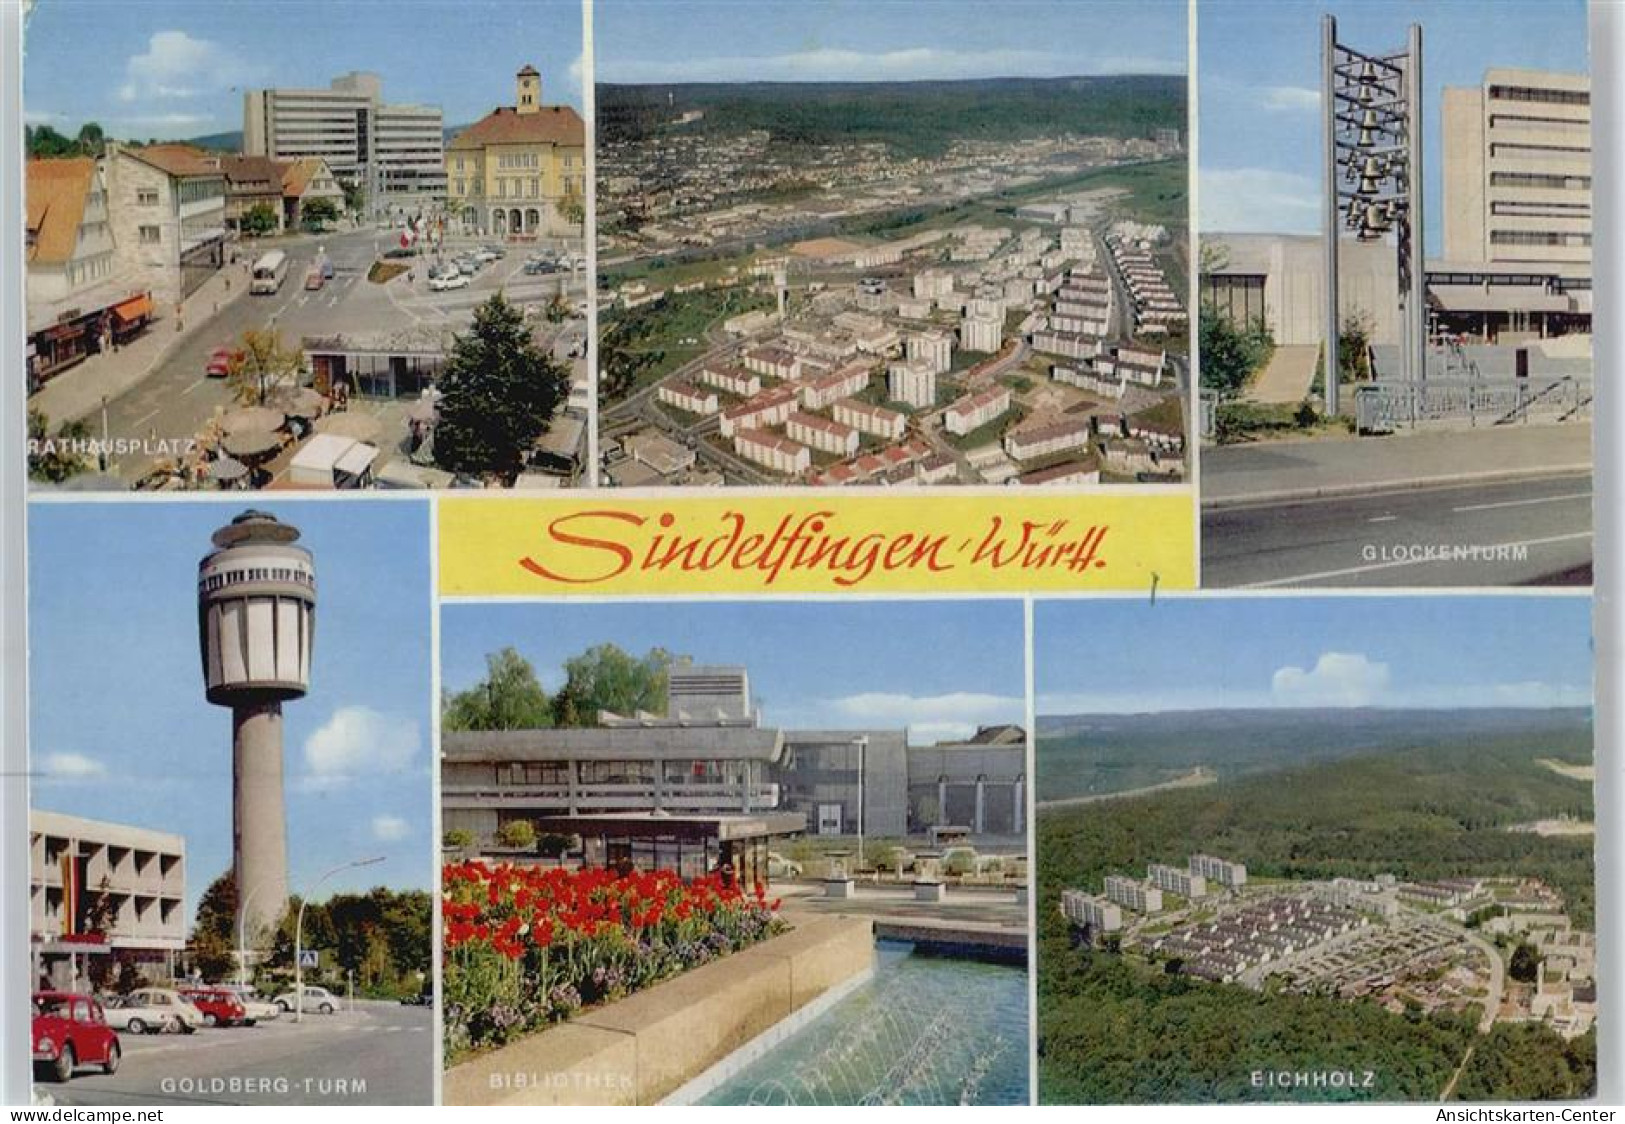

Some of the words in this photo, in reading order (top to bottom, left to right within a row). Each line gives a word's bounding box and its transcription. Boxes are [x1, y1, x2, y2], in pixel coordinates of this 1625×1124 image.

[27, 437, 197, 456] RATHAUSPLATZ
[1362, 543, 1529, 562] GLOCKENTURM
[489, 1072, 633, 1090] BIBLIOTHEK
[1251, 1070, 1376, 1088] EICHHOLZ
